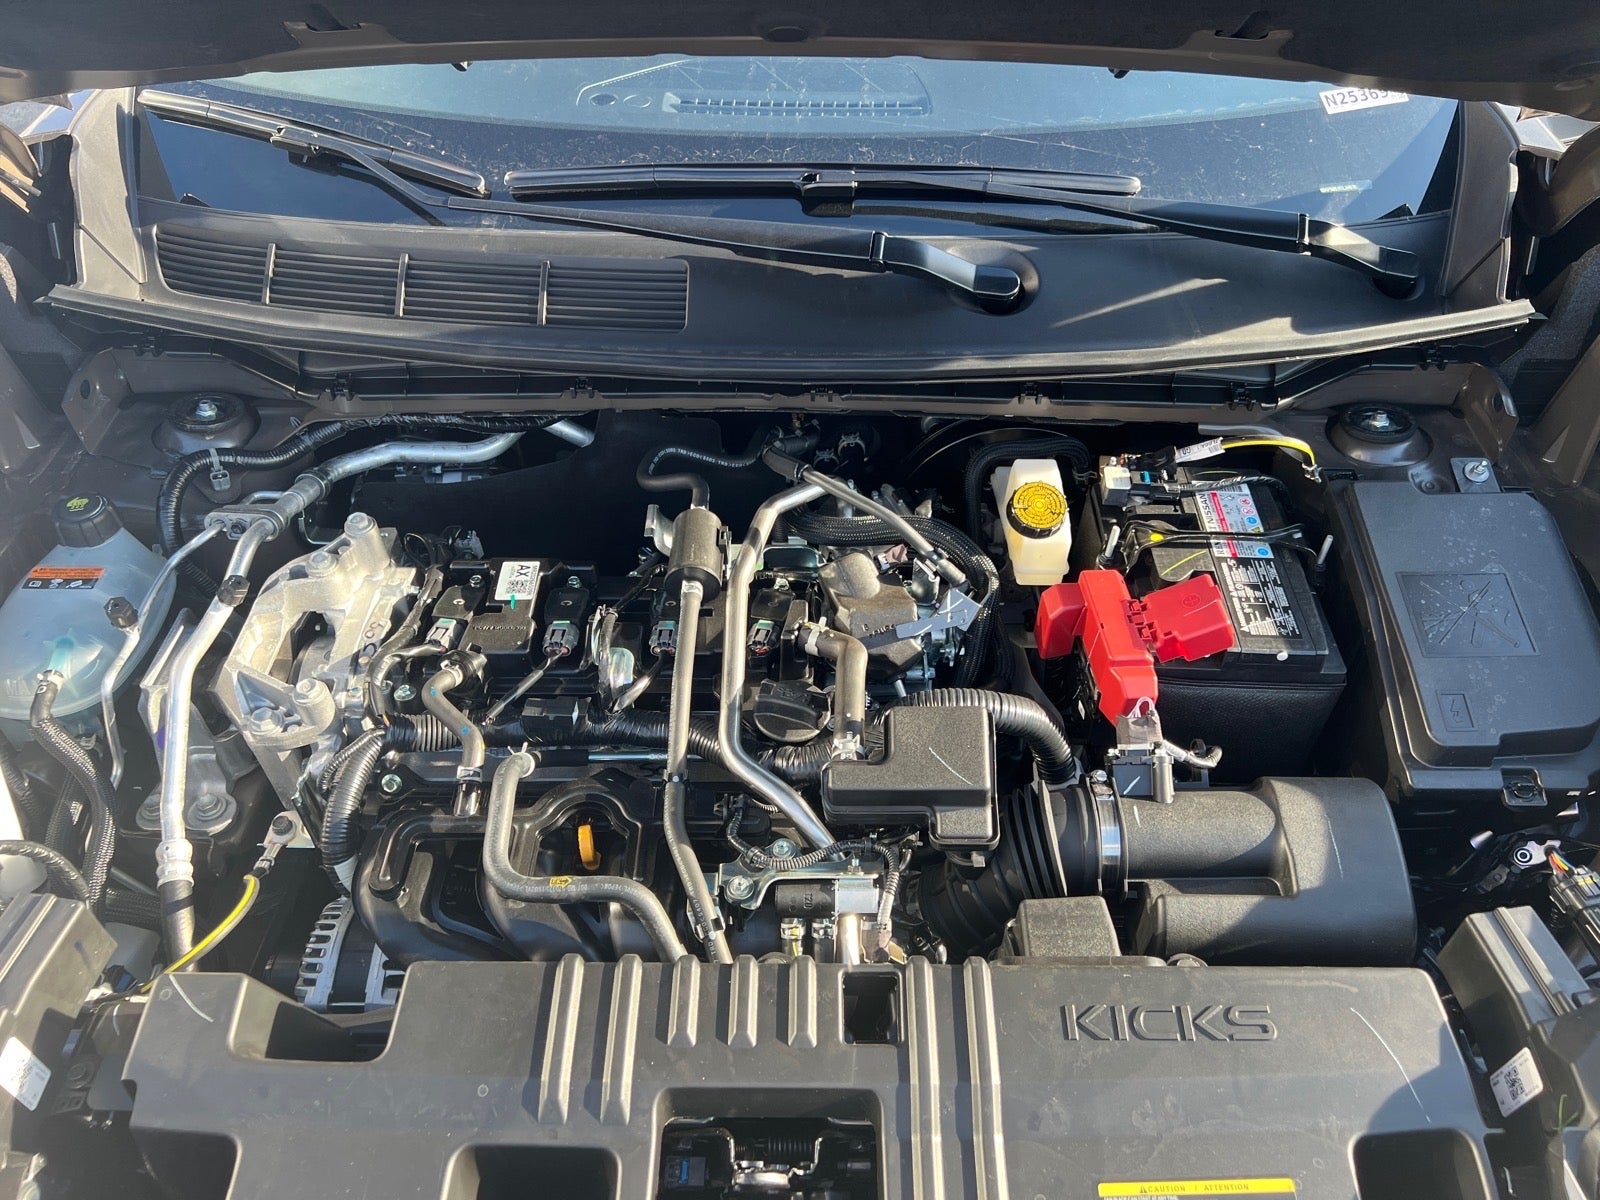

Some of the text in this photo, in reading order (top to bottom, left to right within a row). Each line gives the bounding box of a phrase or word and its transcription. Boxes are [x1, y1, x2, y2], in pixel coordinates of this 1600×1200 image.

[1199, 493, 1214, 523] NISSAN
[515, 564, 531, 578] AX
[1060, 1003, 1278, 1042] KICKS
[1147, 1185, 1186, 1194] CAUTION
[1204, 1183, 1249, 1192] ATTENTION
